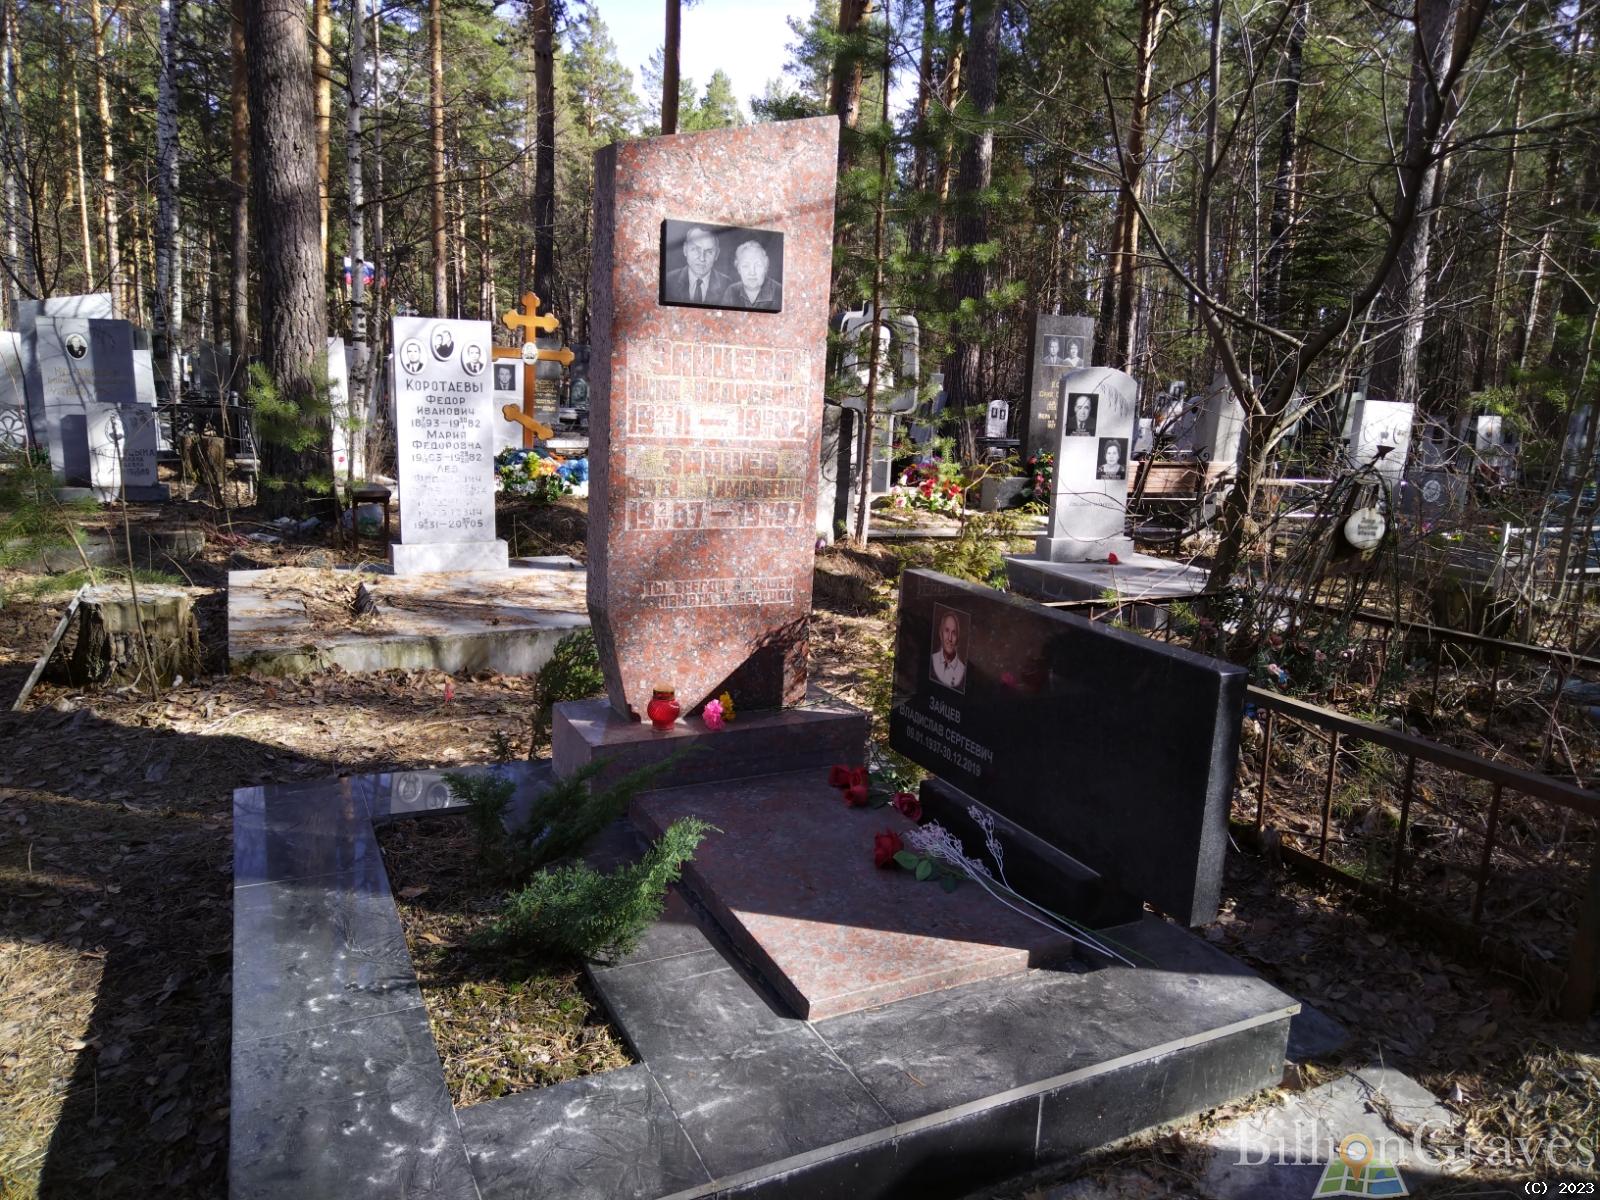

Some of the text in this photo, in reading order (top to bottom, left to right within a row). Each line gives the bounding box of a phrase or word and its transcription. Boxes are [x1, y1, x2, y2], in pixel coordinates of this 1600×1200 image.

[406, 379, 483, 393] КОРОТАЕВЫ
[426, 395, 466, 404] ФЕДОР
[416, 406, 475, 415] ИВАНОВИЧ
[427, 430, 467, 439] МАРИЯ
[412, 440, 482, 450] ФЕДОРОВНА
[929, 696, 961, 723] ЗАЙЦЕВ
[899, 703, 993, 764] ВЛАДИСЛАВ СЕРГЕЕВИЧ
